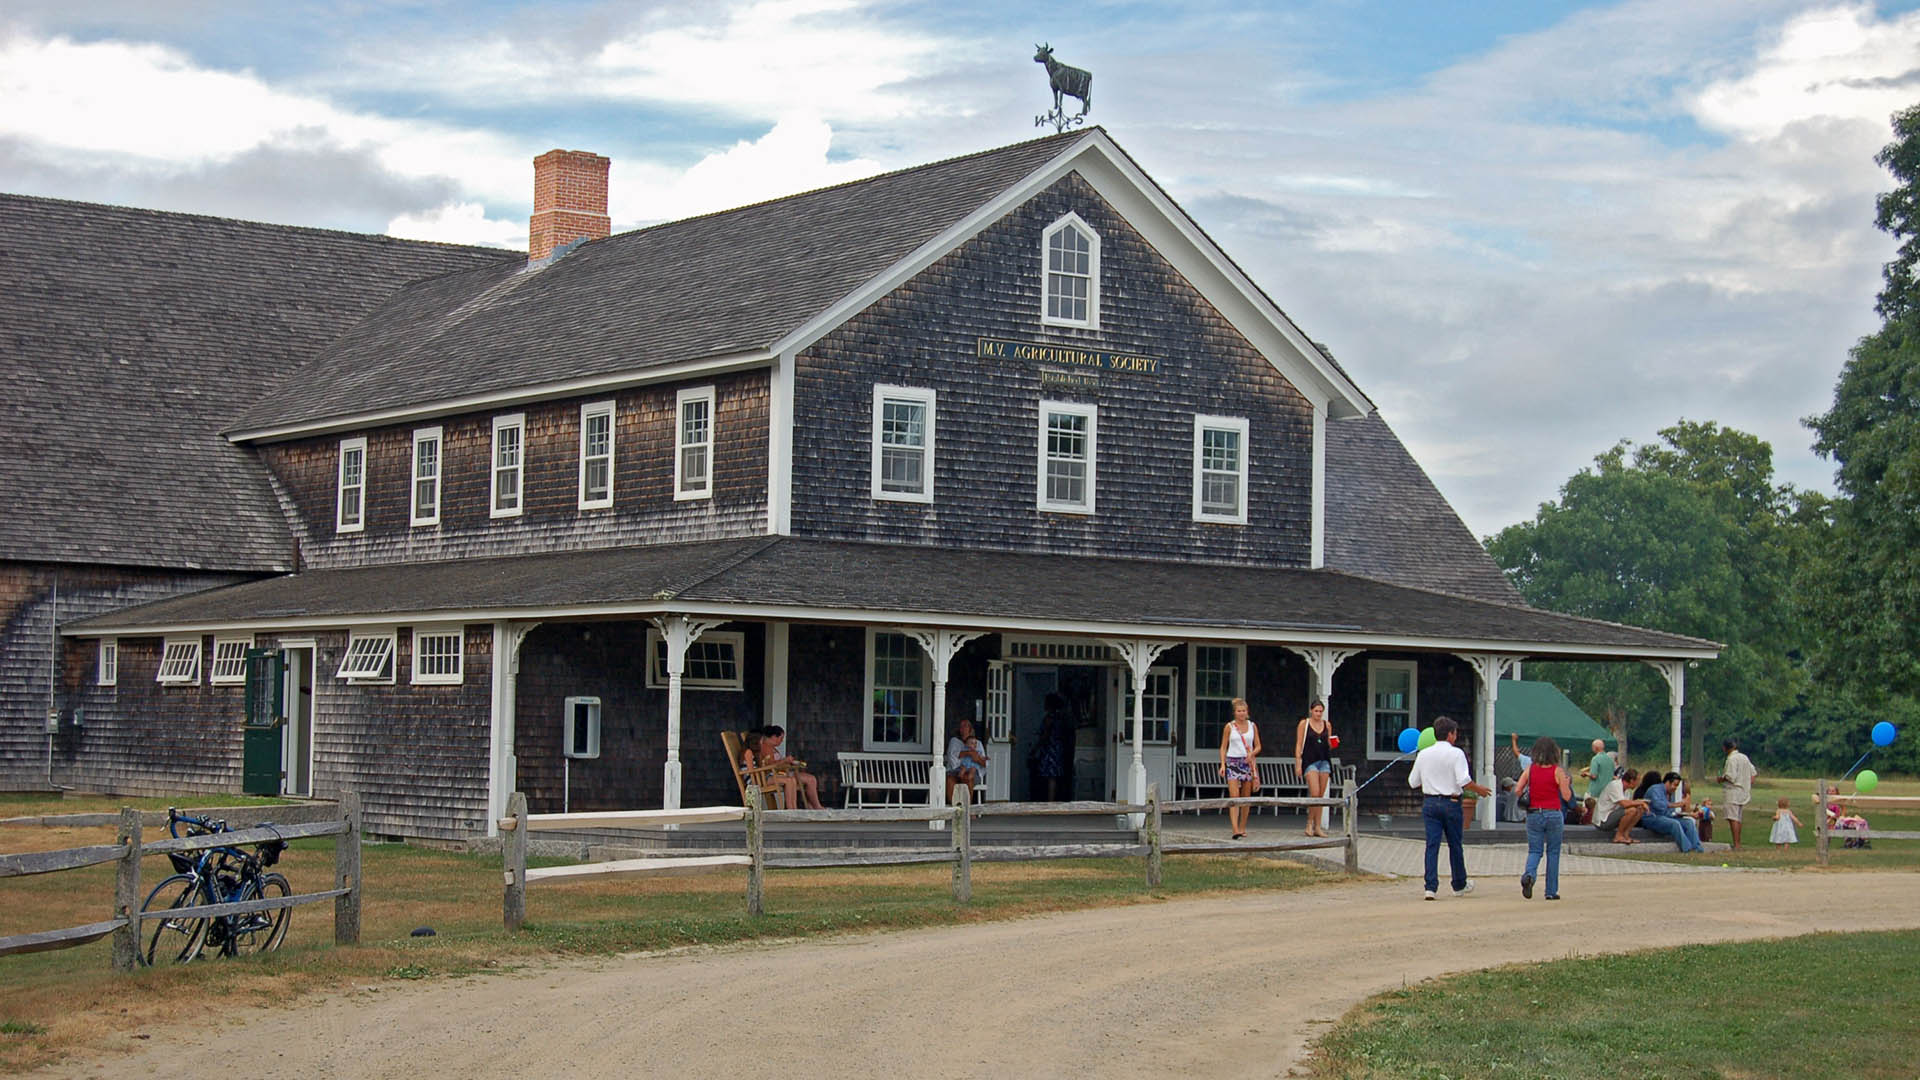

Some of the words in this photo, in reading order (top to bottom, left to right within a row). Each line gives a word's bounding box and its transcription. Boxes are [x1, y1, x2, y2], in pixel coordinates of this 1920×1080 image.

[983, 342, 1006, 357] M.V.
[1013, 345, 1103, 367] AGRICULTURAL
[1109, 355, 1158, 372] SOCIETY
